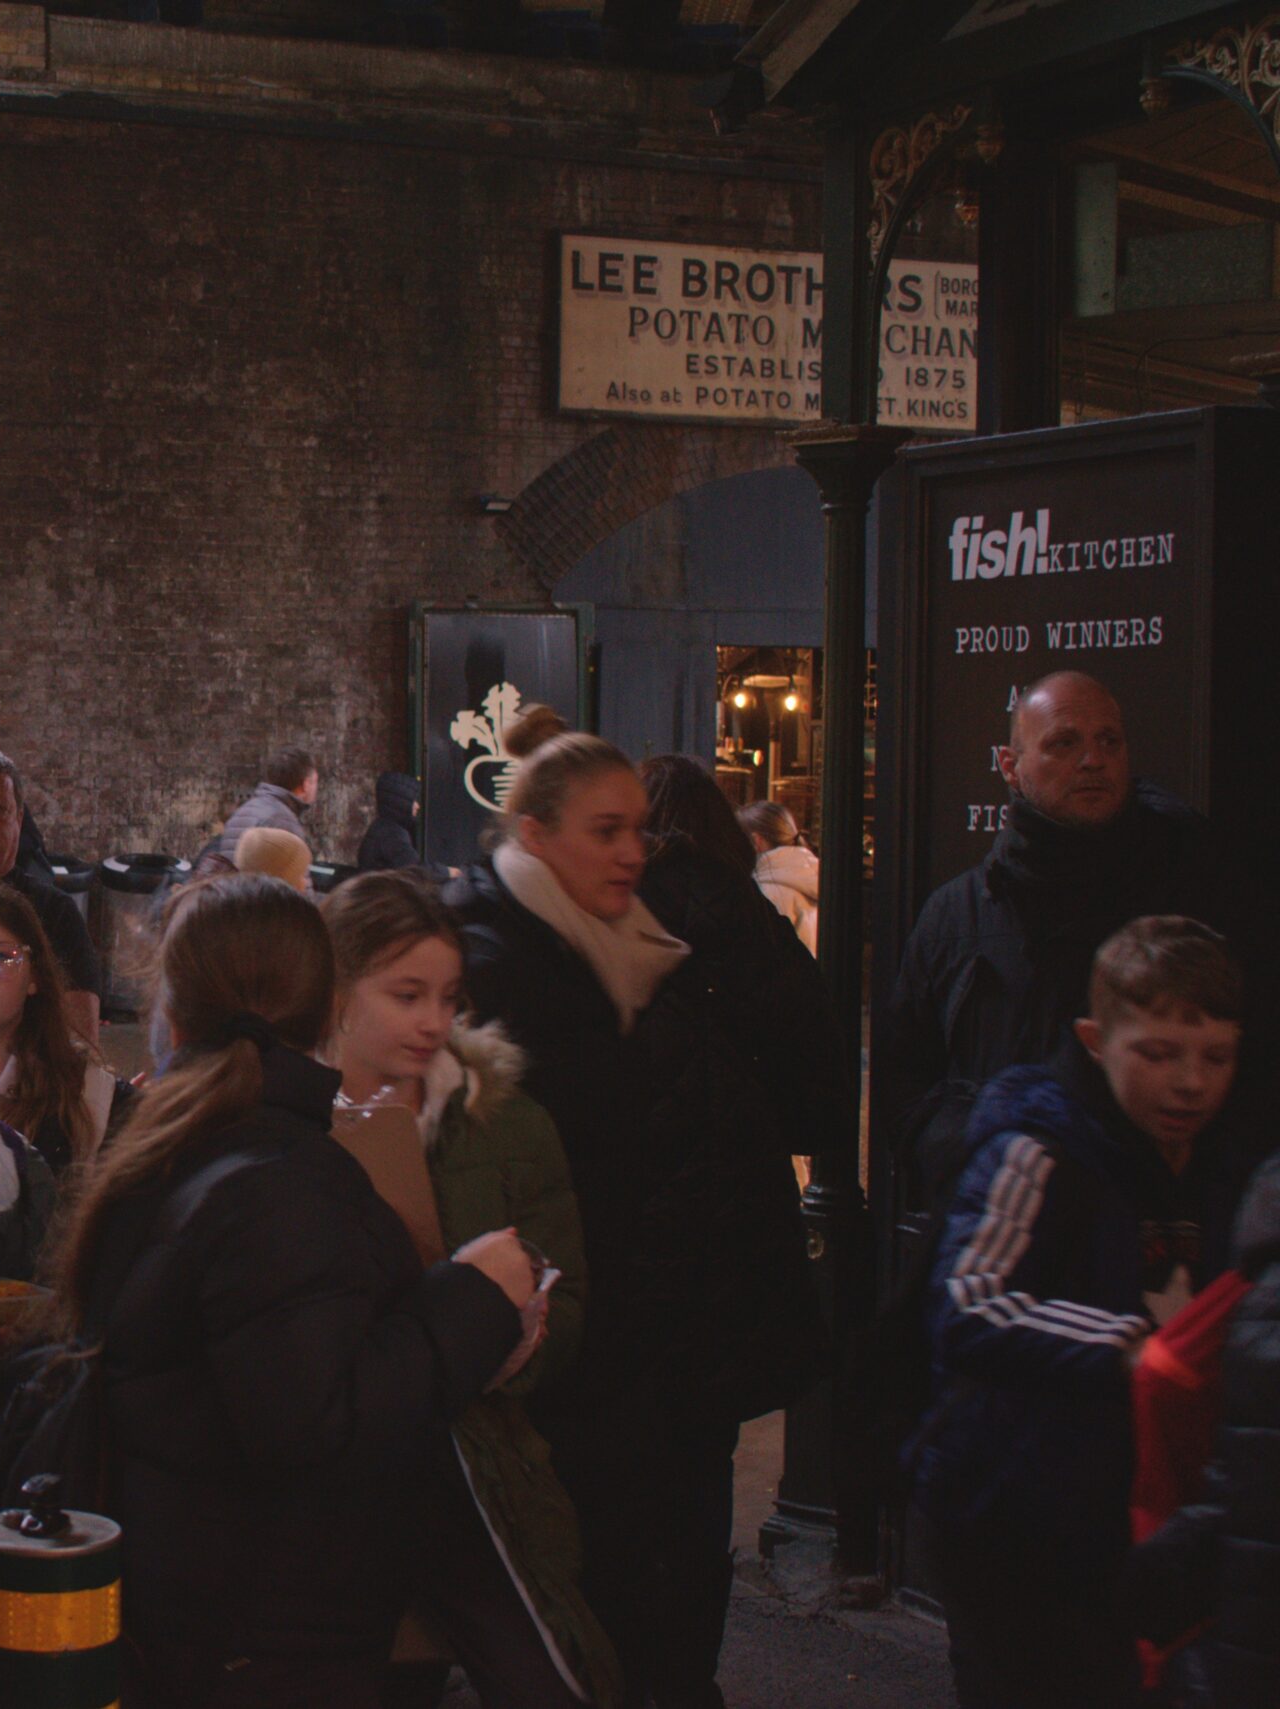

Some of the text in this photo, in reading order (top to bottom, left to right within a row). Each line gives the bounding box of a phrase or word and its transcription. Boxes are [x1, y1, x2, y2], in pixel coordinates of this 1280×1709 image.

[571, 250, 923, 312] LEE BROTHS
[628, 306, 775, 346] POTATO
[606, 382, 651, 403] Also
[660, 386, 681, 404] at
[696, 386, 793, 411] POTATO
[905, 367, 965, 390] 1875
[949, 509, 1174, 581] fish! KITCHEN
[955, 616, 1162, 654] PROUD WINNERS
